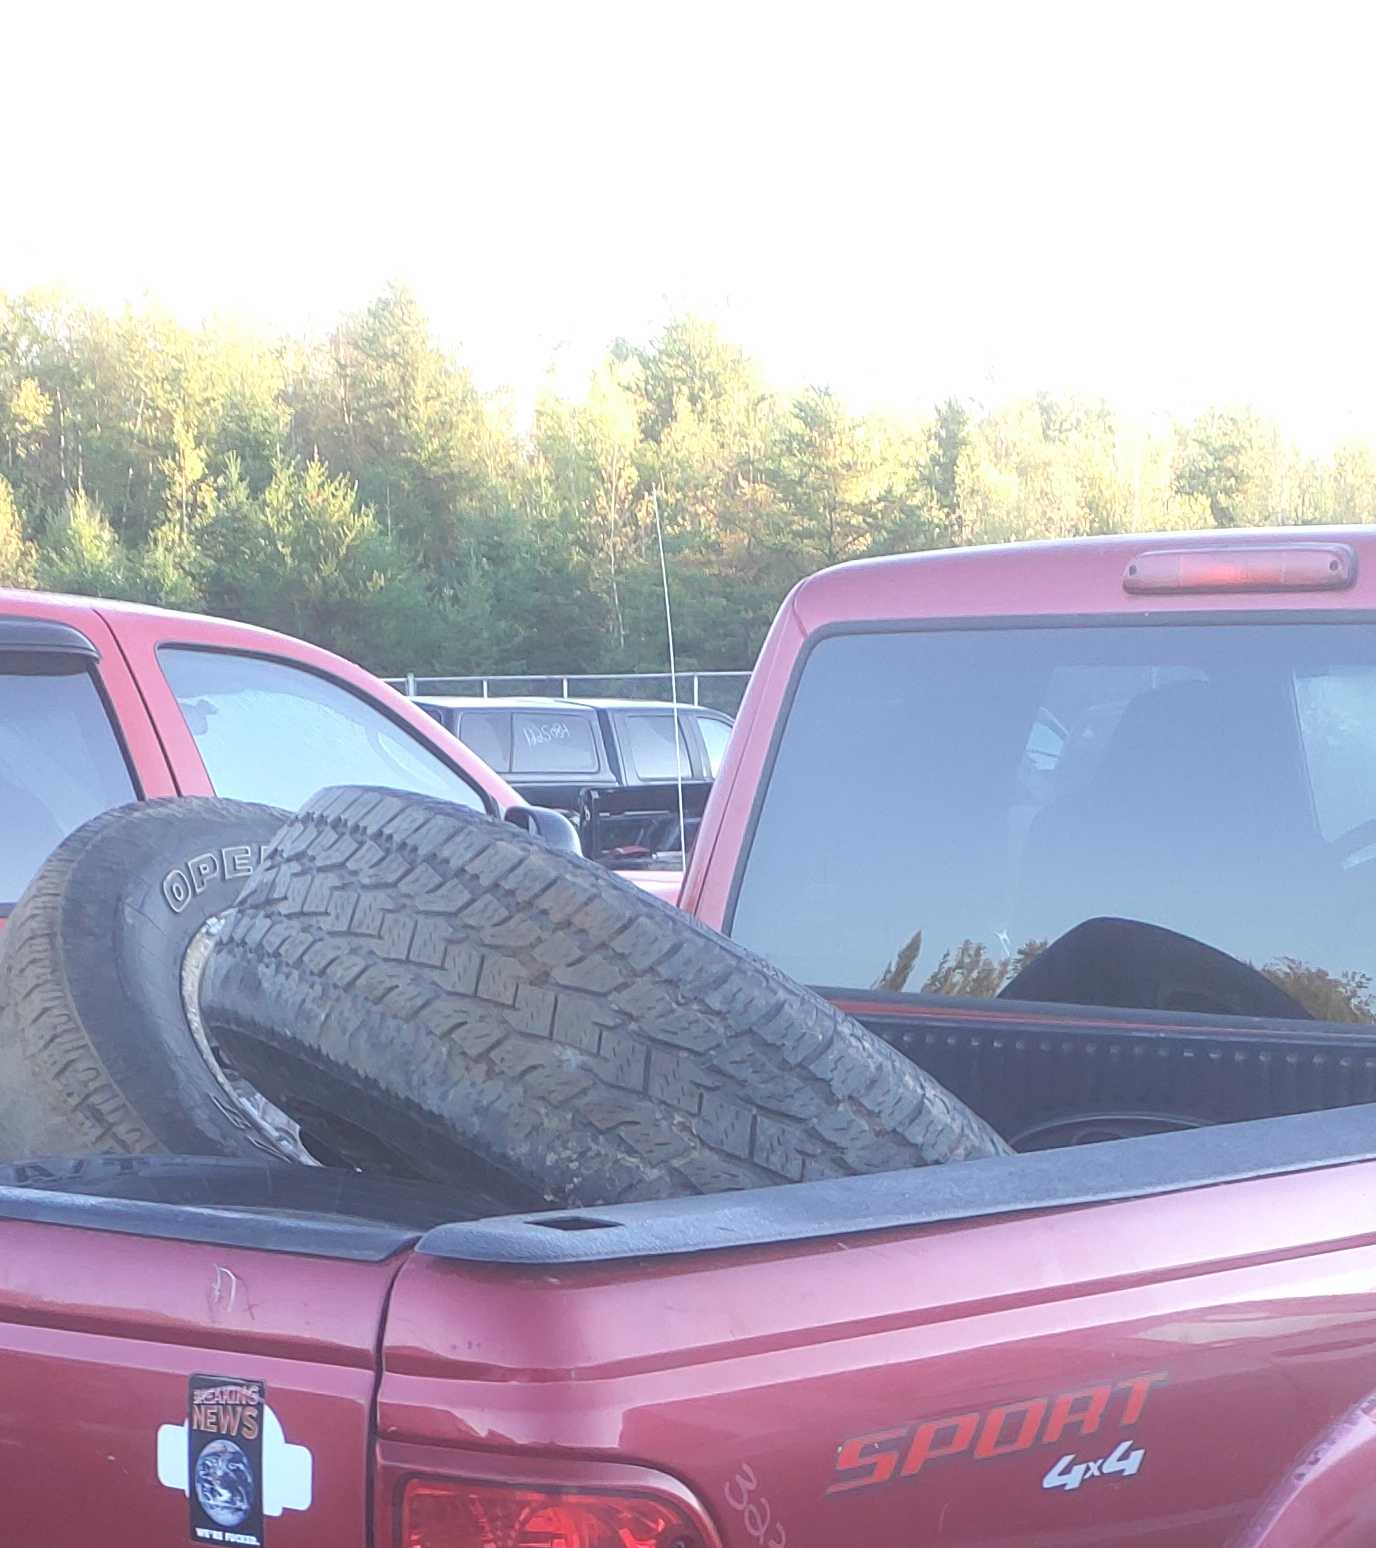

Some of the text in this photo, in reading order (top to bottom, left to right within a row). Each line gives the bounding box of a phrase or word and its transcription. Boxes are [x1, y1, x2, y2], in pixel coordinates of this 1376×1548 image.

[192, 1404, 259, 1440] NEWS
[825, 1373, 1168, 1495] SPORT
[1042, 1440, 1144, 1490] 4x4
